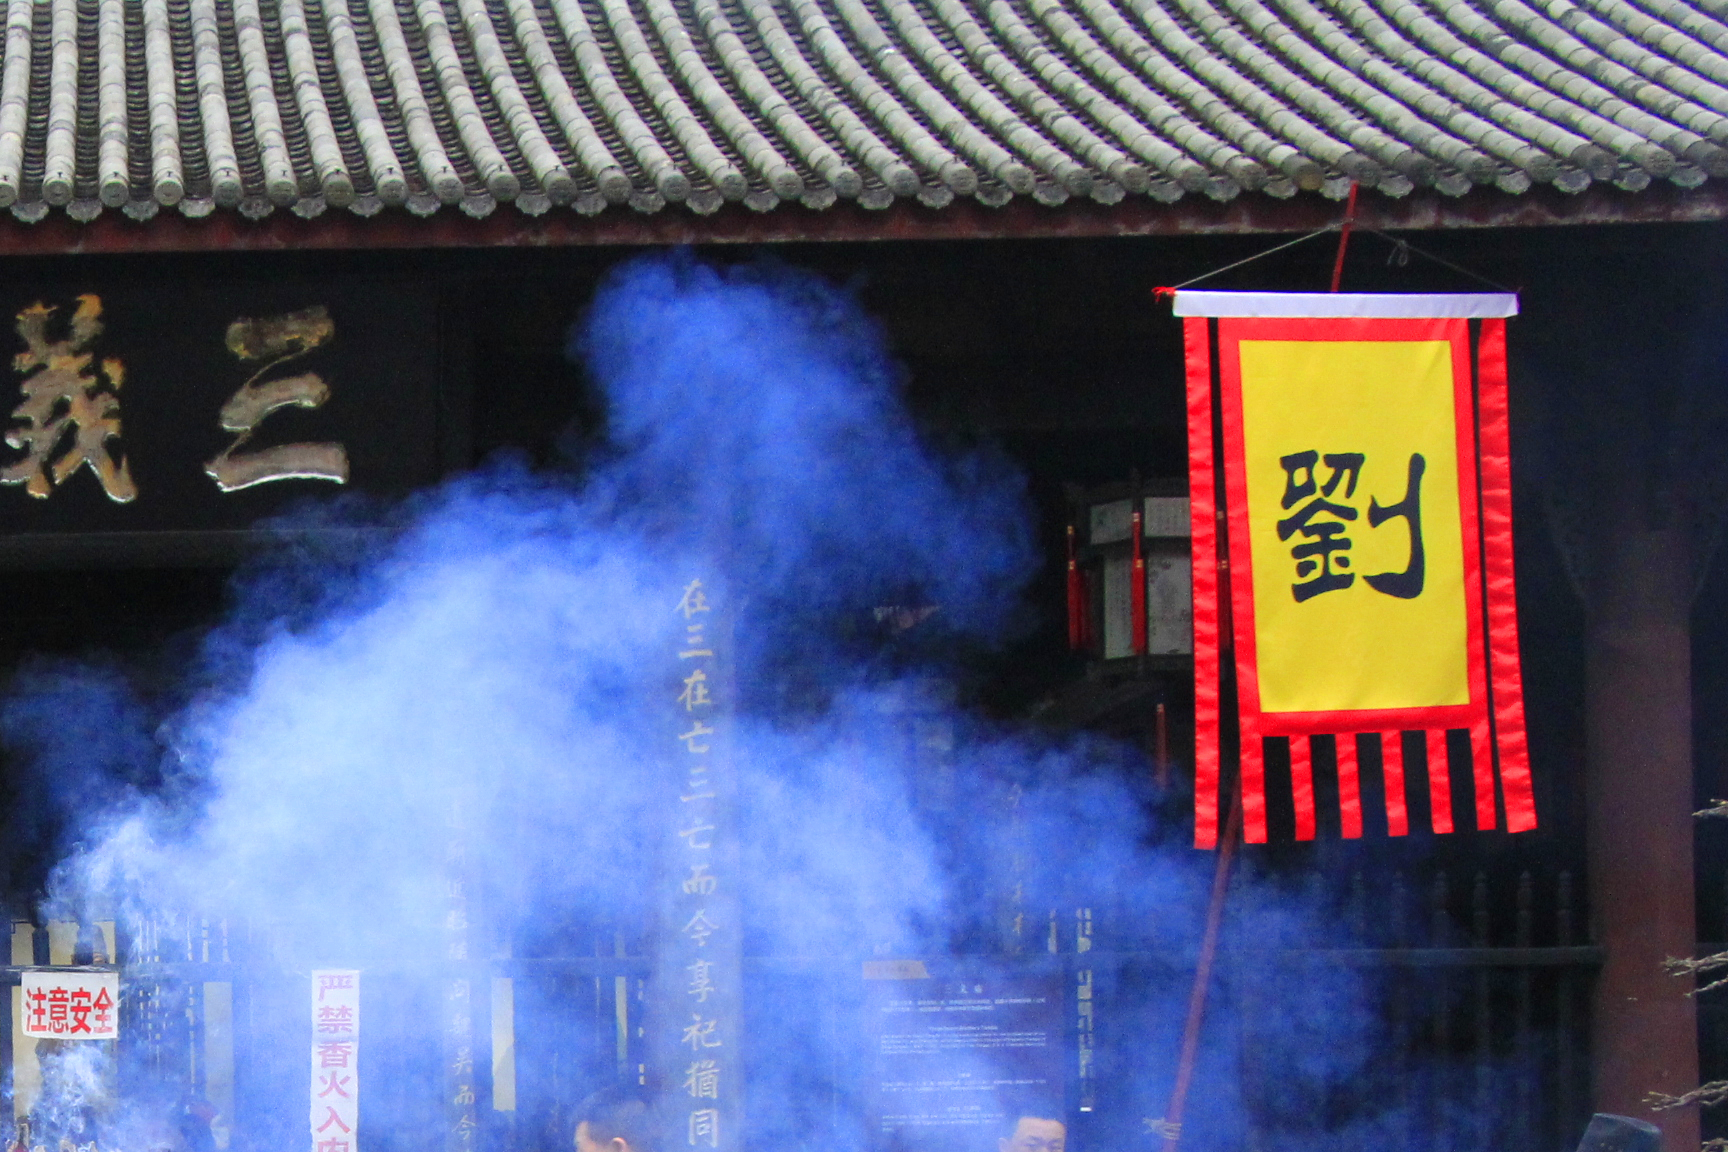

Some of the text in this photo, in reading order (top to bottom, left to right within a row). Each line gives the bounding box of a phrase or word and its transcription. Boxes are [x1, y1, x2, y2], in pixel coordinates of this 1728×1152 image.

[1277, 450, 1426, 603] 劉
[26, 986, 115, 1034] 注意安全
